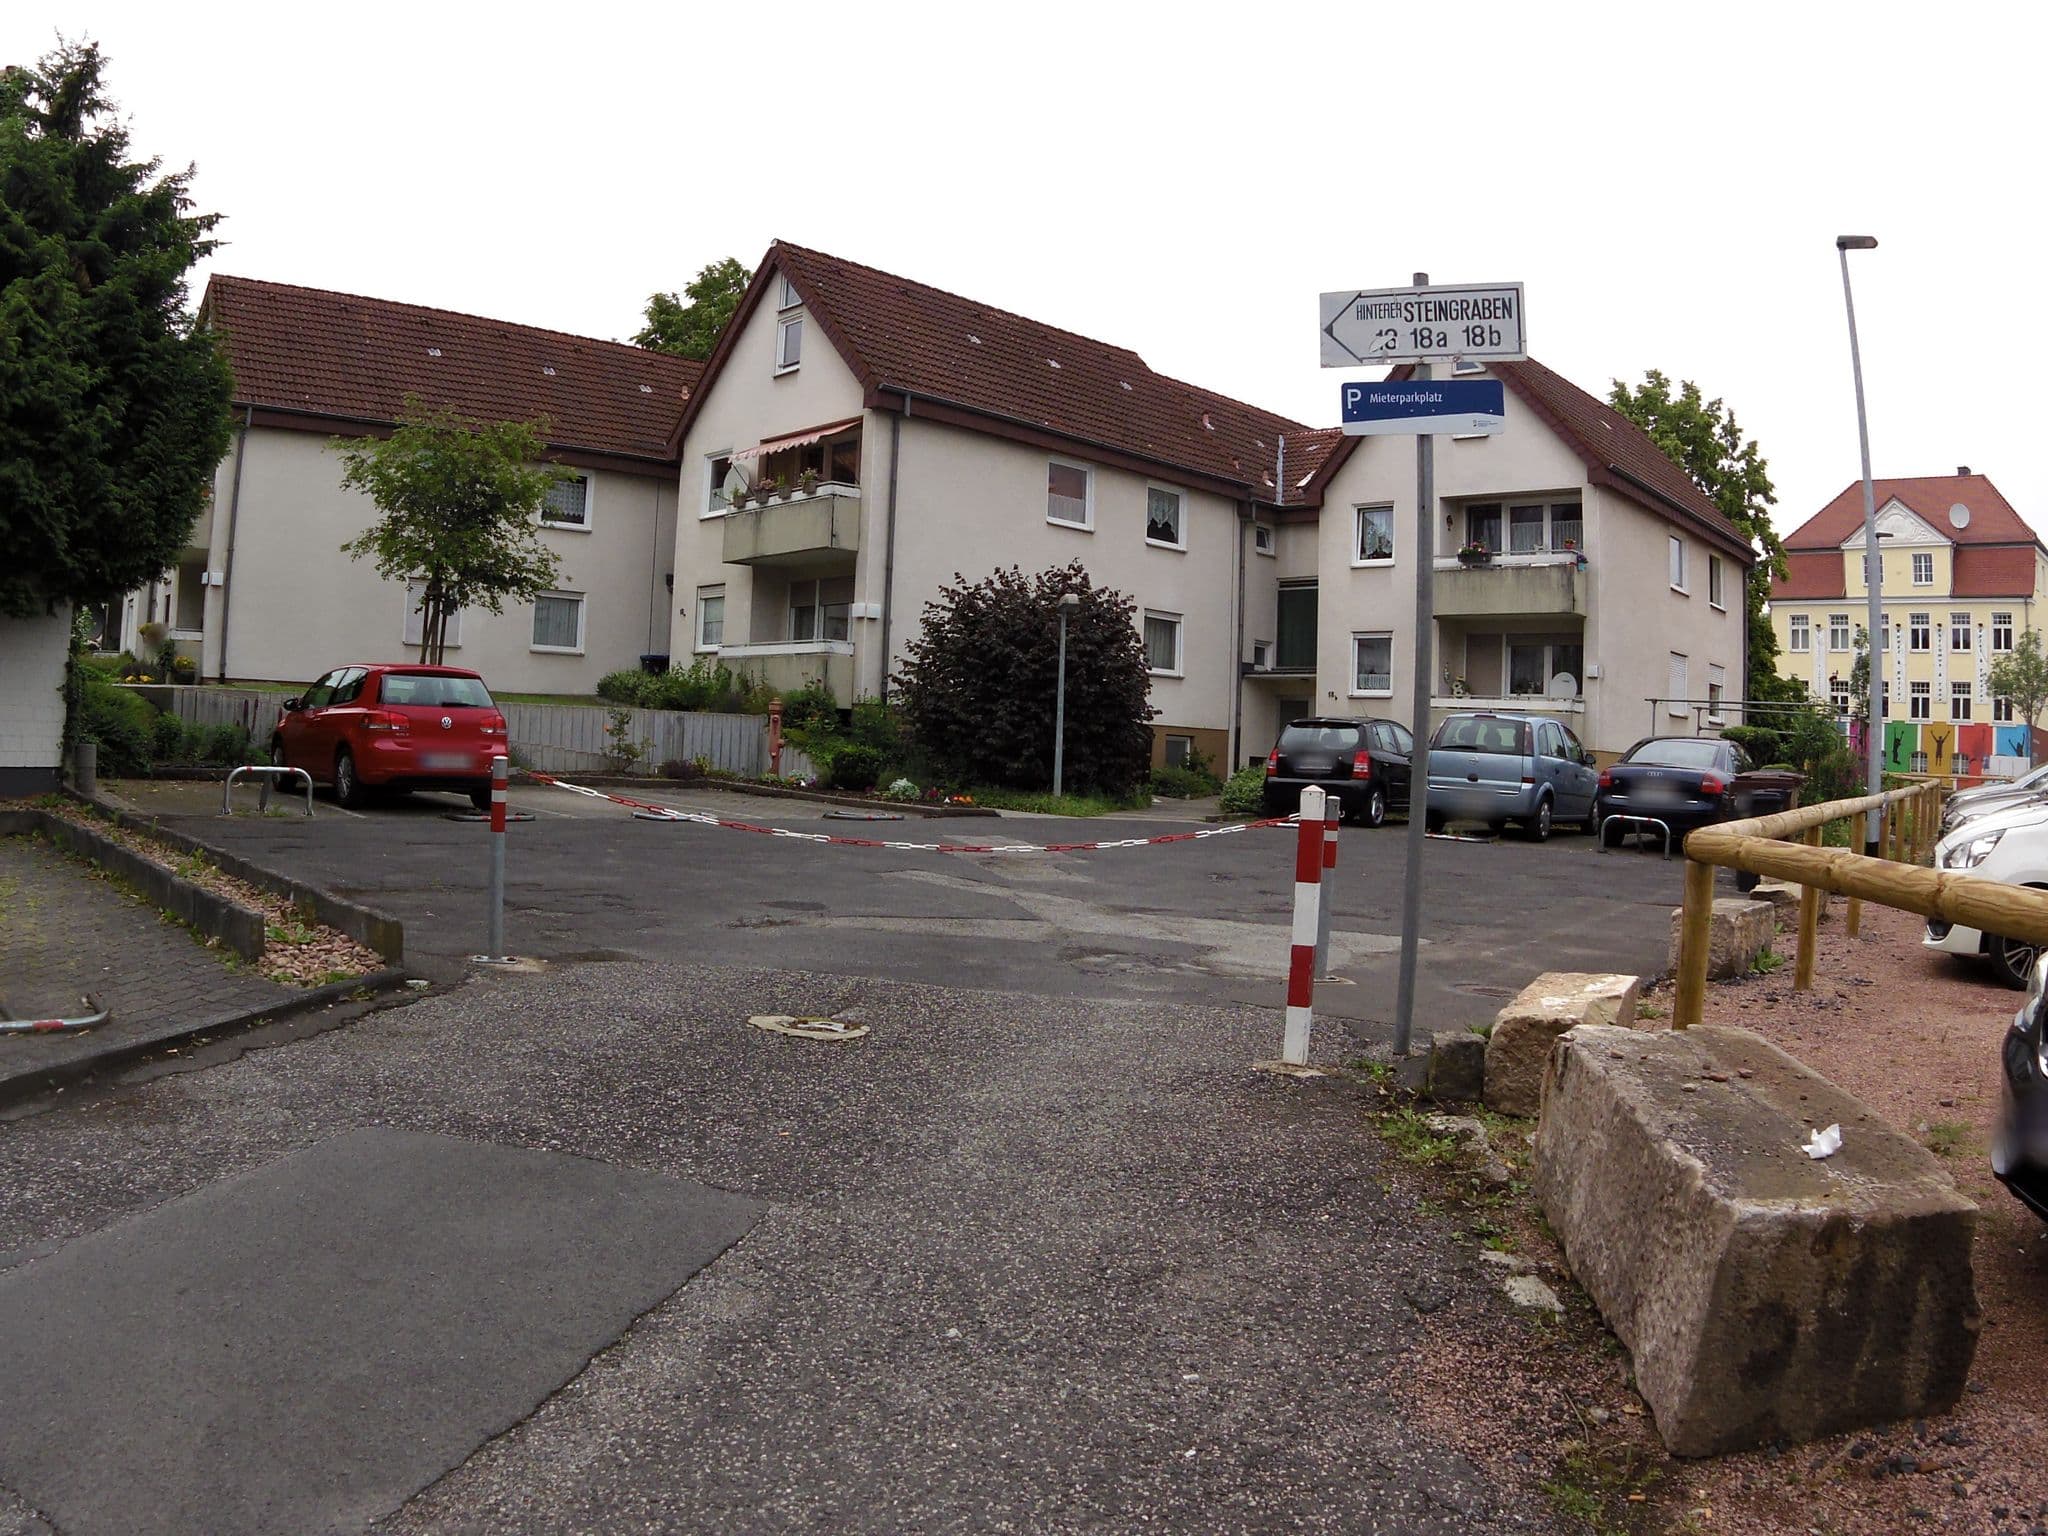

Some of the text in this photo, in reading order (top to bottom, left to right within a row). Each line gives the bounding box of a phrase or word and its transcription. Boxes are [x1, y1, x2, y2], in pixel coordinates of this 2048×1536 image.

[1356, 296, 1513, 323] HINTERER STEINGRABEN
[1346, 388, 1443, 410] P Mieterparkplatz
